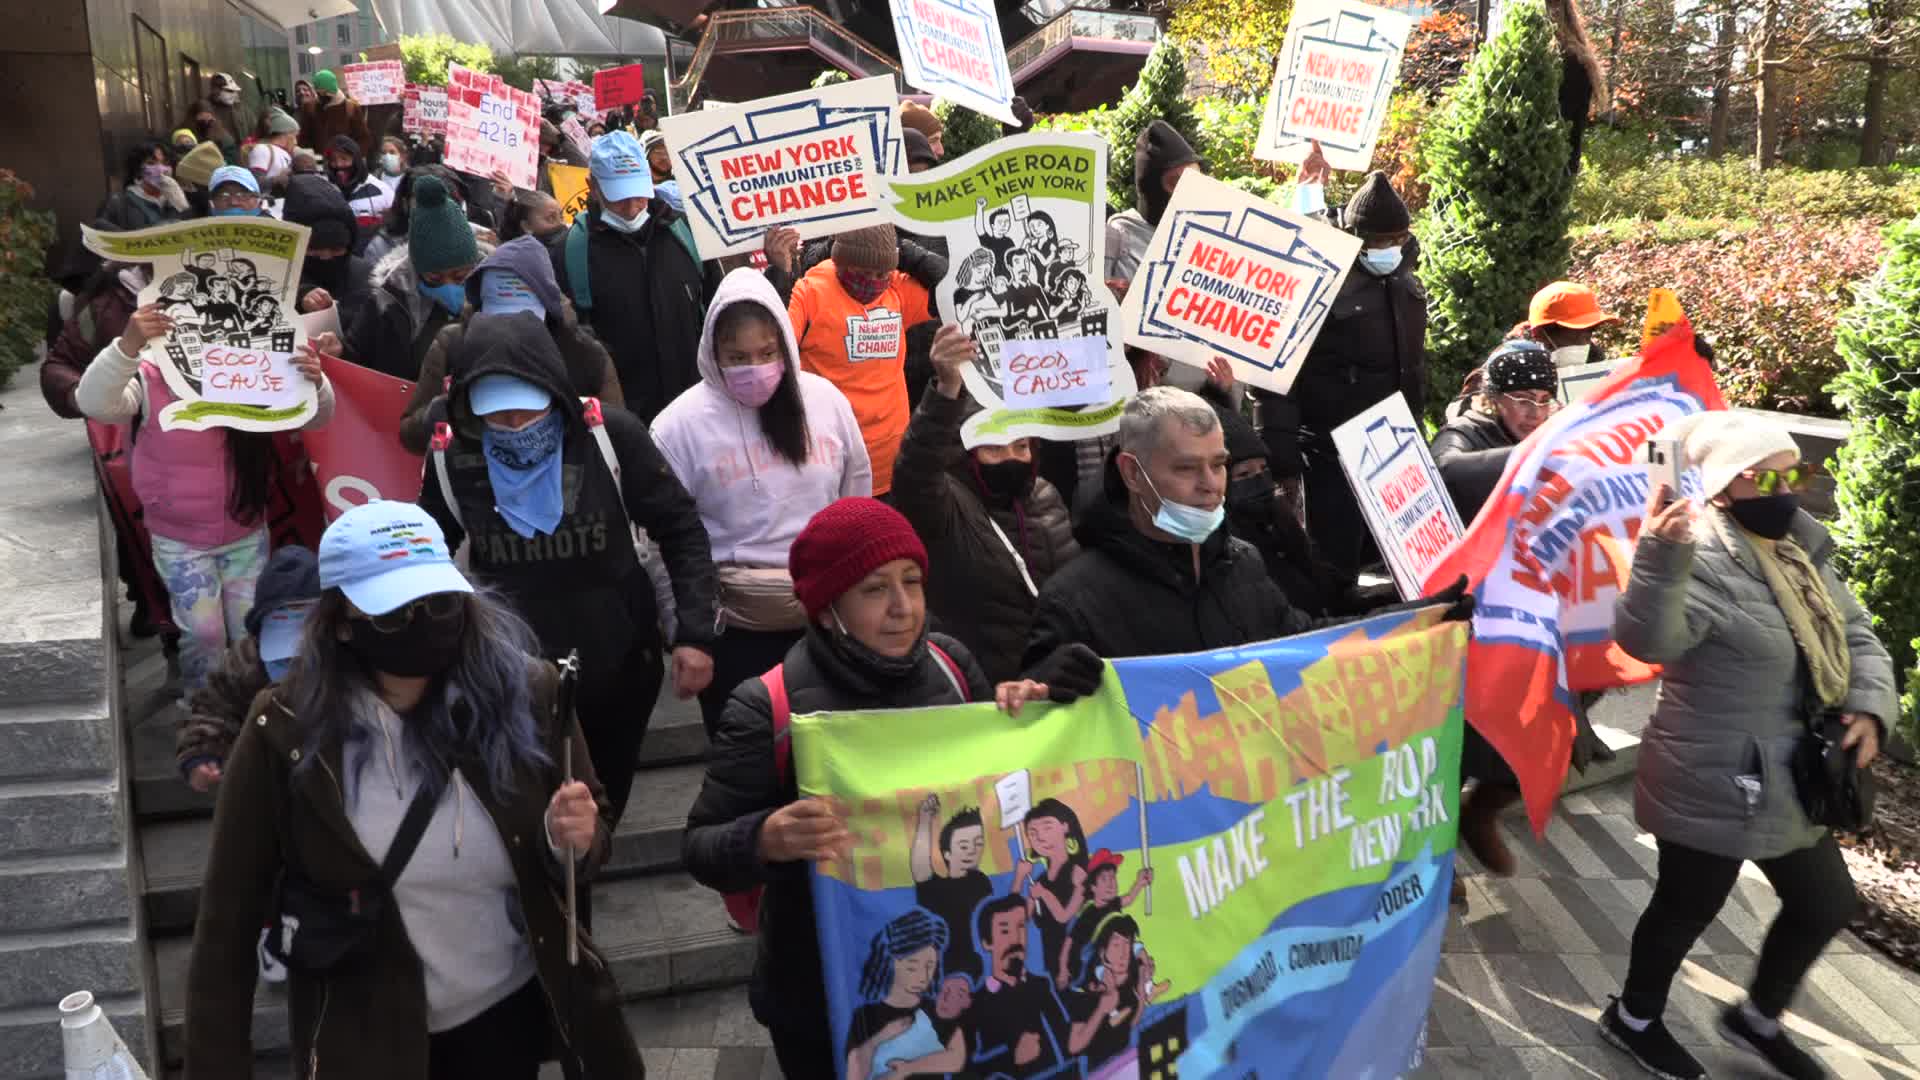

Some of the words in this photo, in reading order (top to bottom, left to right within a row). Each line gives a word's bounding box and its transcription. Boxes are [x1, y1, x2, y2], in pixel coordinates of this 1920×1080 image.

[946, 11, 980, 42] YORK
[922, 37, 993, 87] CHANGE
[1305, 51, 1339, 79] NEW
[1340, 58, 1376, 86] YORK
[479, 94, 513, 121] End
[1291, 97, 1364, 135] CHANGE
[720, 149, 781, 180] NEW
[784, 135, 859, 166] YORK
[728, 160, 853, 194] COMMUNITIES
[915, 177, 977, 208] MAKE
[976, 155, 1020, 187] THE
[1025, 153, 1089, 174] ROAD
[995, 175, 1036, 199] NEW
[1041, 175, 1088, 193] YORK
[731, 173, 867, 221] CHANGE
[126, 236, 183, 250] MAKE
[190, 227, 225, 240] THE
[233, 227, 293, 243] ROAD
[203, 239, 242, 248] NEW
[247, 240, 289, 253] YORK
[1188, 240, 1244, 280] NEW
[1240, 258, 1301, 301] YORK
[1181, 269, 1283, 316] COMMUNITIES
[1166, 287, 1281, 350] CHANGE
[856, 341, 896, 353] CHANGE
[1008, 351, 1069, 373] GOOD
[210, 372, 284, 392] CAUSE
[1013, 369, 1089, 396] CAUSE
[1380, 482, 1408, 513] NEW
[1399, 463, 1427, 494] YORK
[1405, 510, 1453, 575] CHANGE
[1177, 810, 1270, 920] MAKE
[1283, 767, 1356, 849] THE
[1349, 812, 1403, 871] NEW
